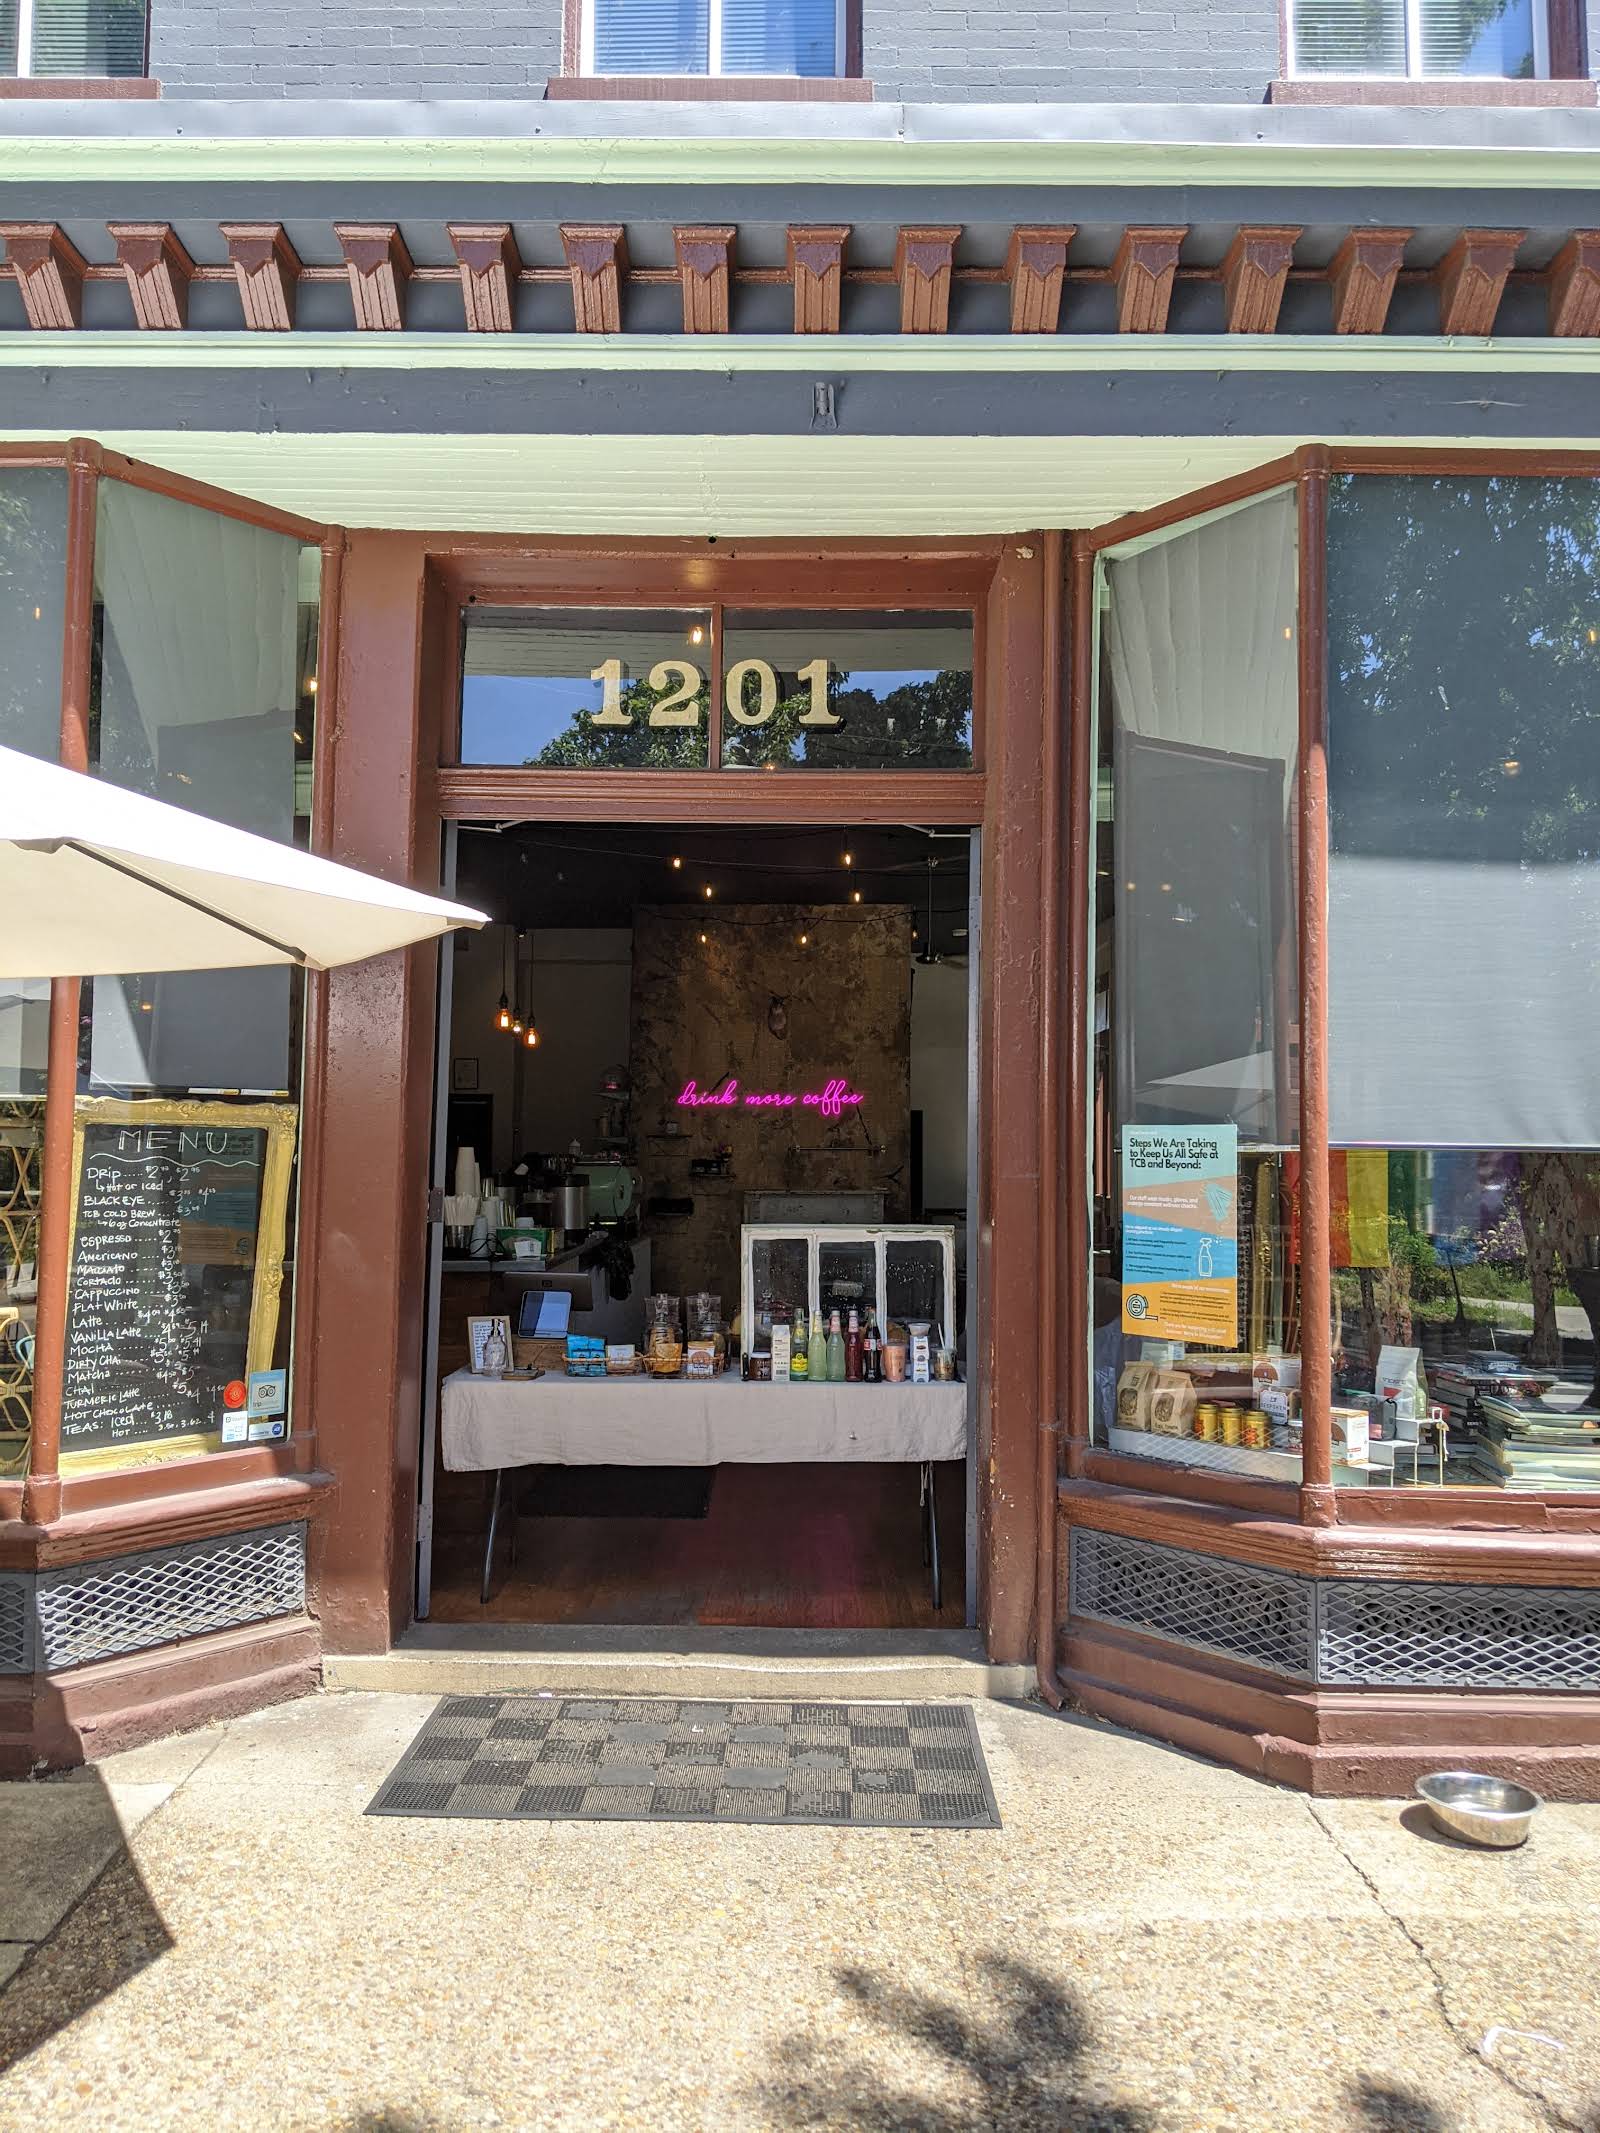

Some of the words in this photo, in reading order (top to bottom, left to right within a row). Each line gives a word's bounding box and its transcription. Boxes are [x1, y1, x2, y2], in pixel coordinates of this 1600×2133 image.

[590, 658, 841, 727] 1201
[678, 1080, 737, 1106] drink
[745, 1094, 797, 1106] more
[802, 1080, 864, 1116] coffee
[118, 1130, 228, 1155] MENU
[1129, 1137, 1151, 1149] Steps
[1153, 1138, 1168, 1148] We
[1169, 1138, 1186, 1148] Are
[1187, 1138, 1217, 1151] Taking
[1129, 1148, 1138, 1158] to
[1140, 1148, 1161, 1160] Keep
[1162, 1148, 1173, 1158] Us
[1174, 1148, 1186, 1159] All
[1188, 1149, 1208, 1159] Safe
[1209, 1150, 1219, 1159] at
[1129, 1158, 1146, 1168] TCB
[1147, 1158, 1164, 1168] and
[1165, 1159, 1202, 1171] Beyond:
[84, 1196, 120, 1206] BLACK
[82, 1210, 100, 1218] TCB
[103, 1210, 128, 1218] COLD
[70, 1342, 115, 1357] MOCHA
